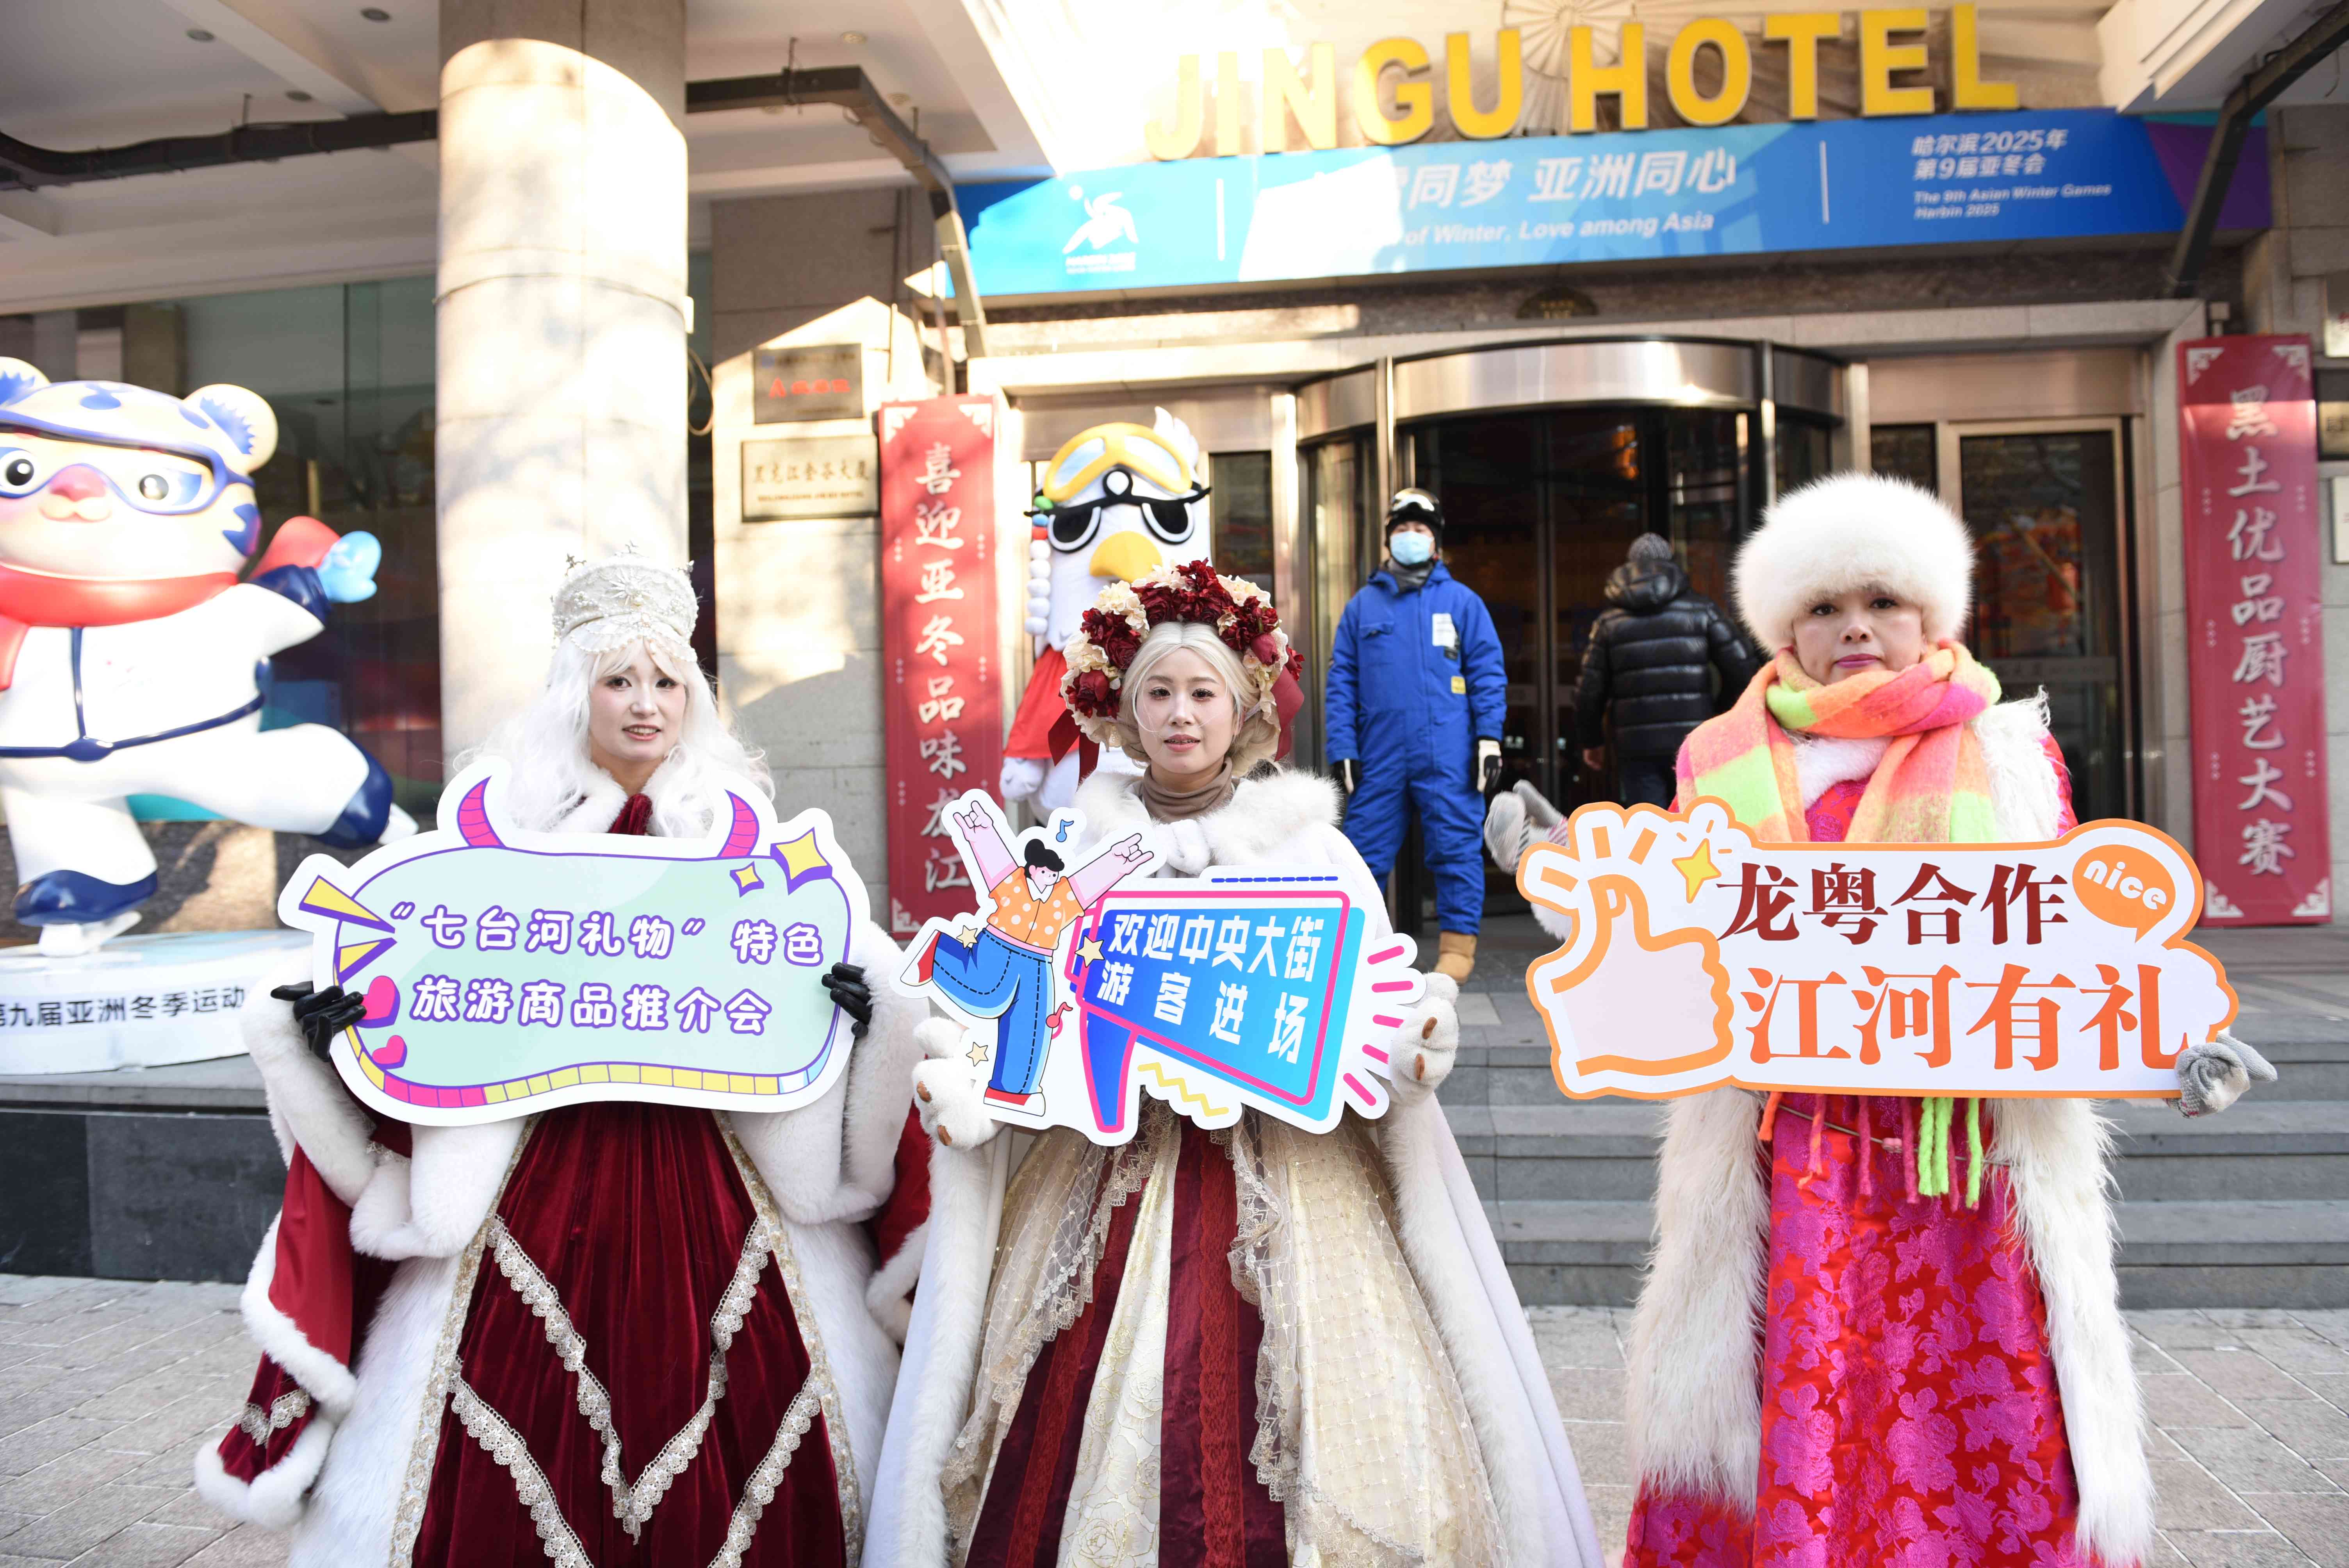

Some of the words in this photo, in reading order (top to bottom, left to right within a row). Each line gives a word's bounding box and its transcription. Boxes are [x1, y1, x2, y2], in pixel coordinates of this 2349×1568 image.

[1144, 27, 1522, 161] JINGU
[1569, 2, 2020, 133] HOTEL
[1912, 128, 2068, 156] 哈尔滨2025年
[1913, 152, 2046, 181] 第9届亚冬会
[1527, 146, 1736, 202] 亚洲同心
[1914, 191, 1941, 204] The
[1969, 187, 2010, 201] Asian
[2012, 185, 2059, 200] Winter
[2060, 183, 2112, 198] Games
[1519, 219, 1572, 240] Love
[1579, 217, 1656, 239] among
[1663, 210, 1715, 231] Asia
[1914, 206, 1962, 220] Harbin
[1965, 203, 2000, 218] 2025
[2226, 384, 2296, 876] 黑土优品厨艺大赛
[1716, 862, 2068, 946] 龙粤合作
[2083, 860, 2167, 910] nice
[1108, 913, 1324, 982] 欢迎中央大街
[0, 986, 244, 1028] 九届亚洲冬季运动
[409, 974, 772, 1035] 旅游商品推介会
[1097, 961, 1310, 1065] 游客进场
[1741, 963, 2189, 1071] 江河有礼
